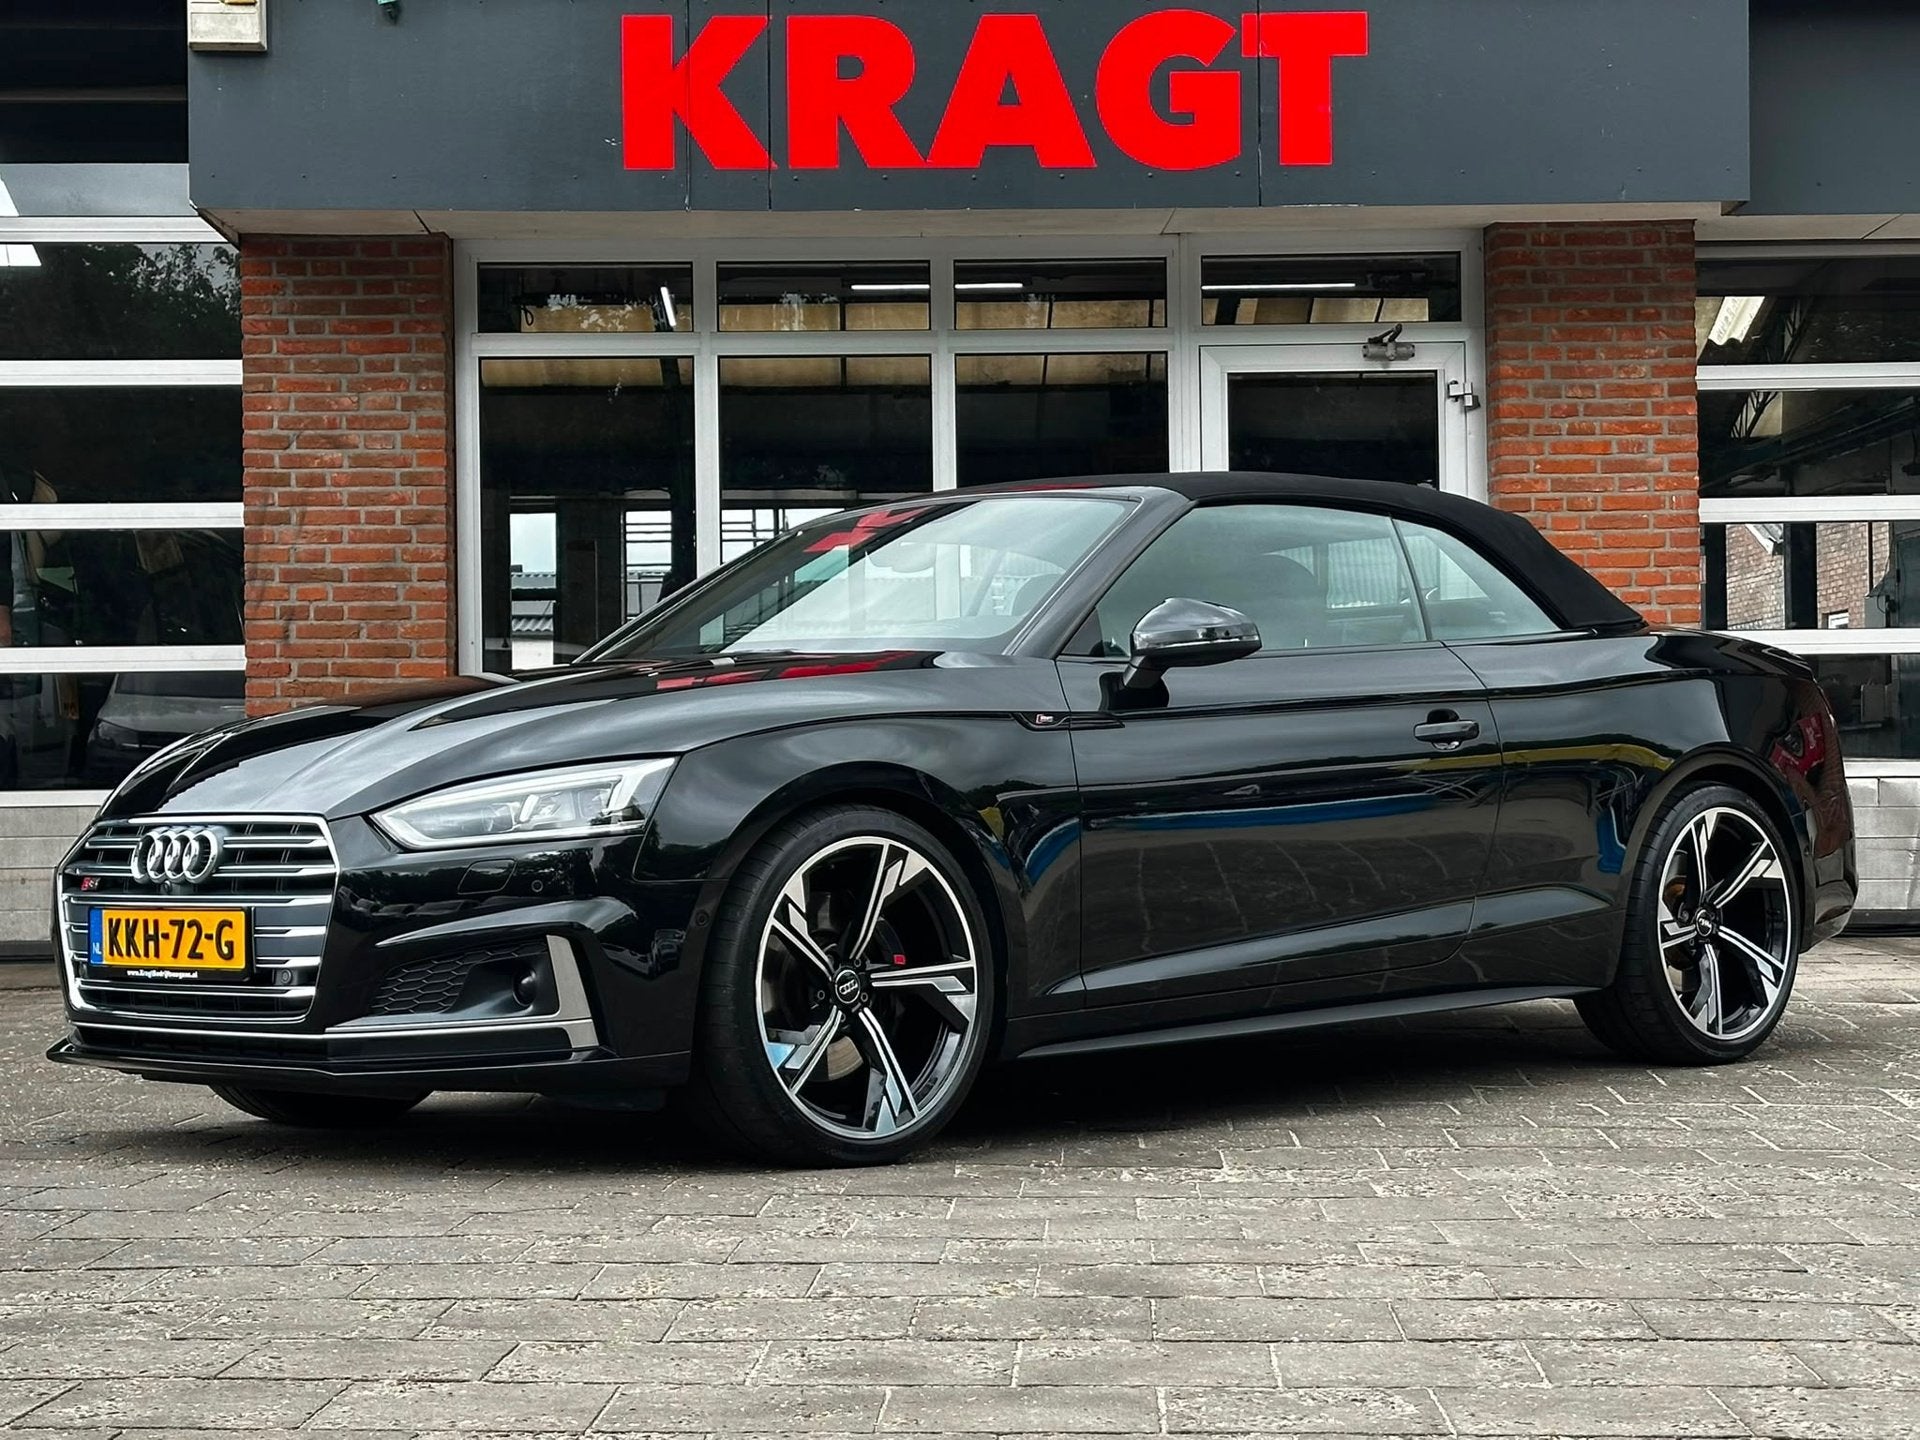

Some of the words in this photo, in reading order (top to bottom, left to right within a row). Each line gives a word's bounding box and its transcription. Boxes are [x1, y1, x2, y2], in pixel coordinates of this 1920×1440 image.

[621, 9, 1368, 170] KRAGT
[92, 942, 102, 955] NL
[108, 917, 235, 961] KKH-72-G
